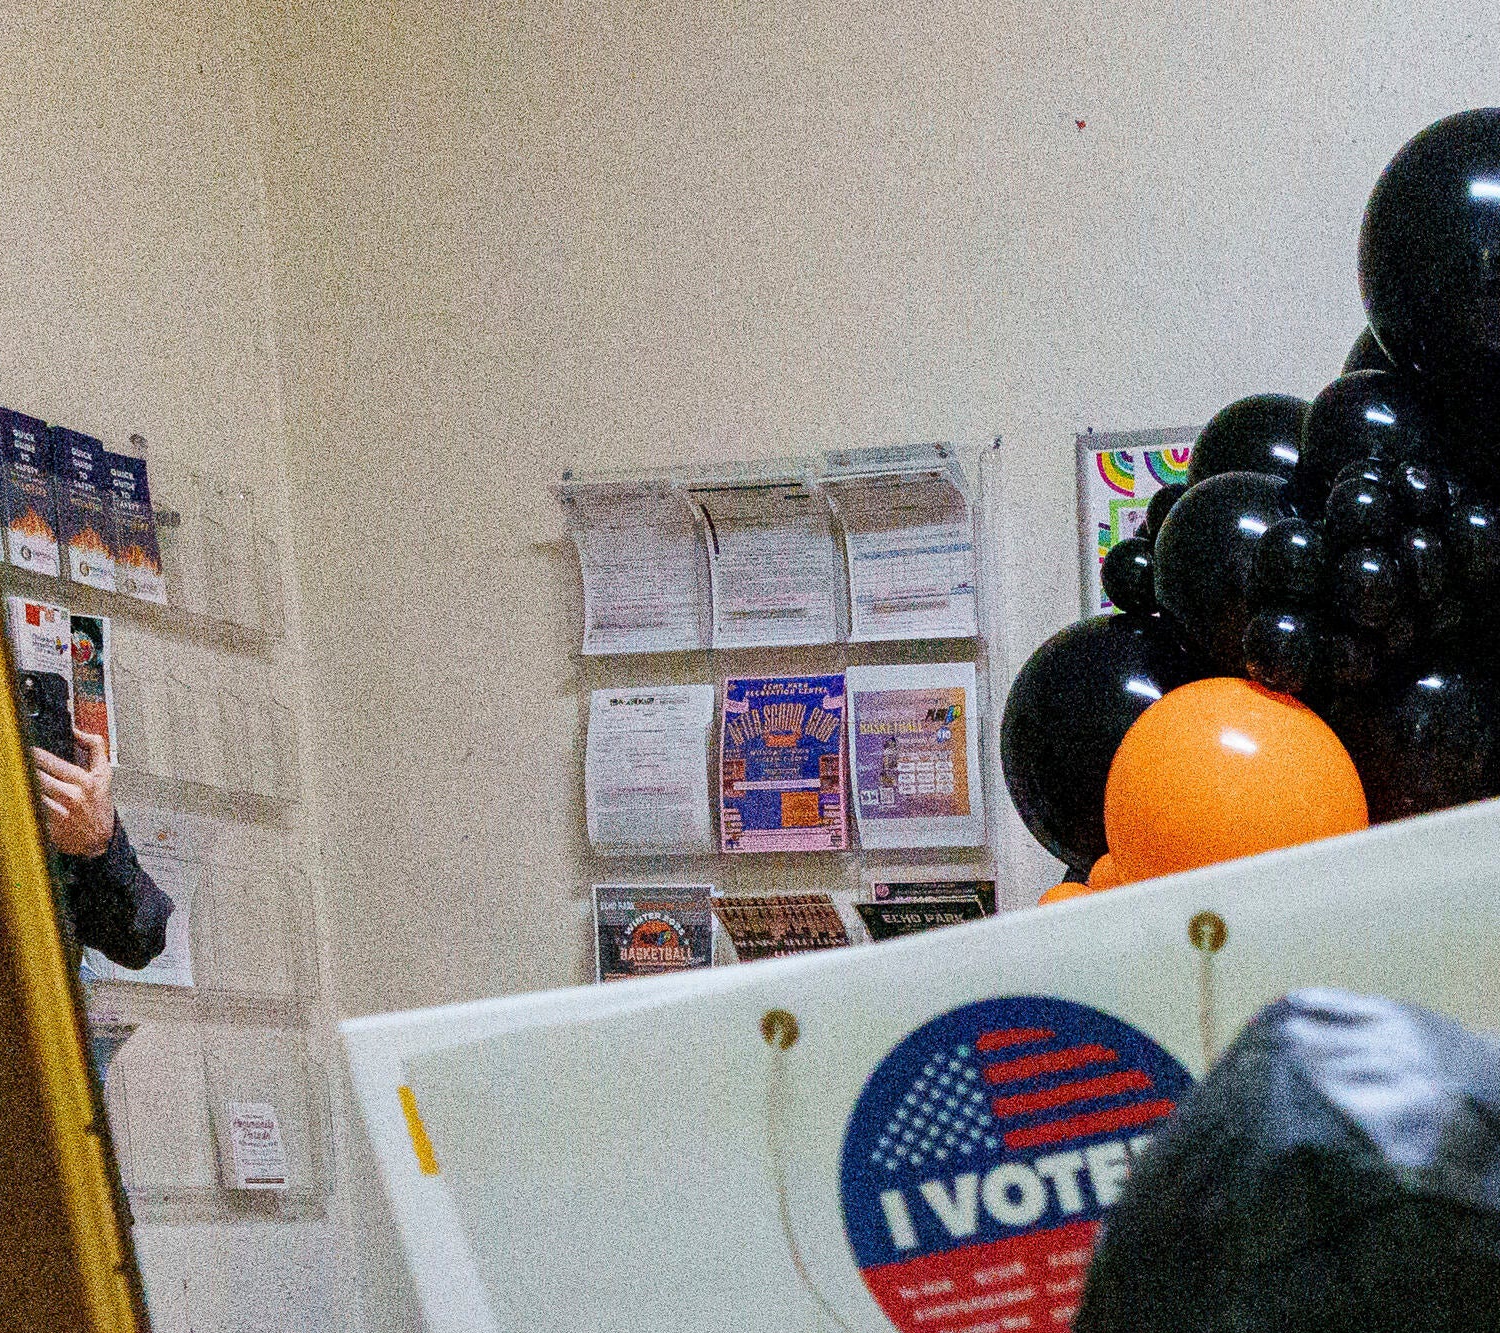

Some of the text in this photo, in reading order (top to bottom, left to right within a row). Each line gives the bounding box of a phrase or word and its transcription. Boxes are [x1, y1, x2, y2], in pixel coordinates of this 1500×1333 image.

[71, 448, 93, 461] QUICK
[109, 469, 135, 481] QUICK
[763, 703, 807, 731] SCHOOL
[805, 707, 839, 742] CLUB
[624, 911, 663, 935] WINTER
[882, 913, 965, 924] ECHO PARK
[620, 947, 693, 962] BASKETBALL
[880, 1134, 1153, 1250] I VOTE
